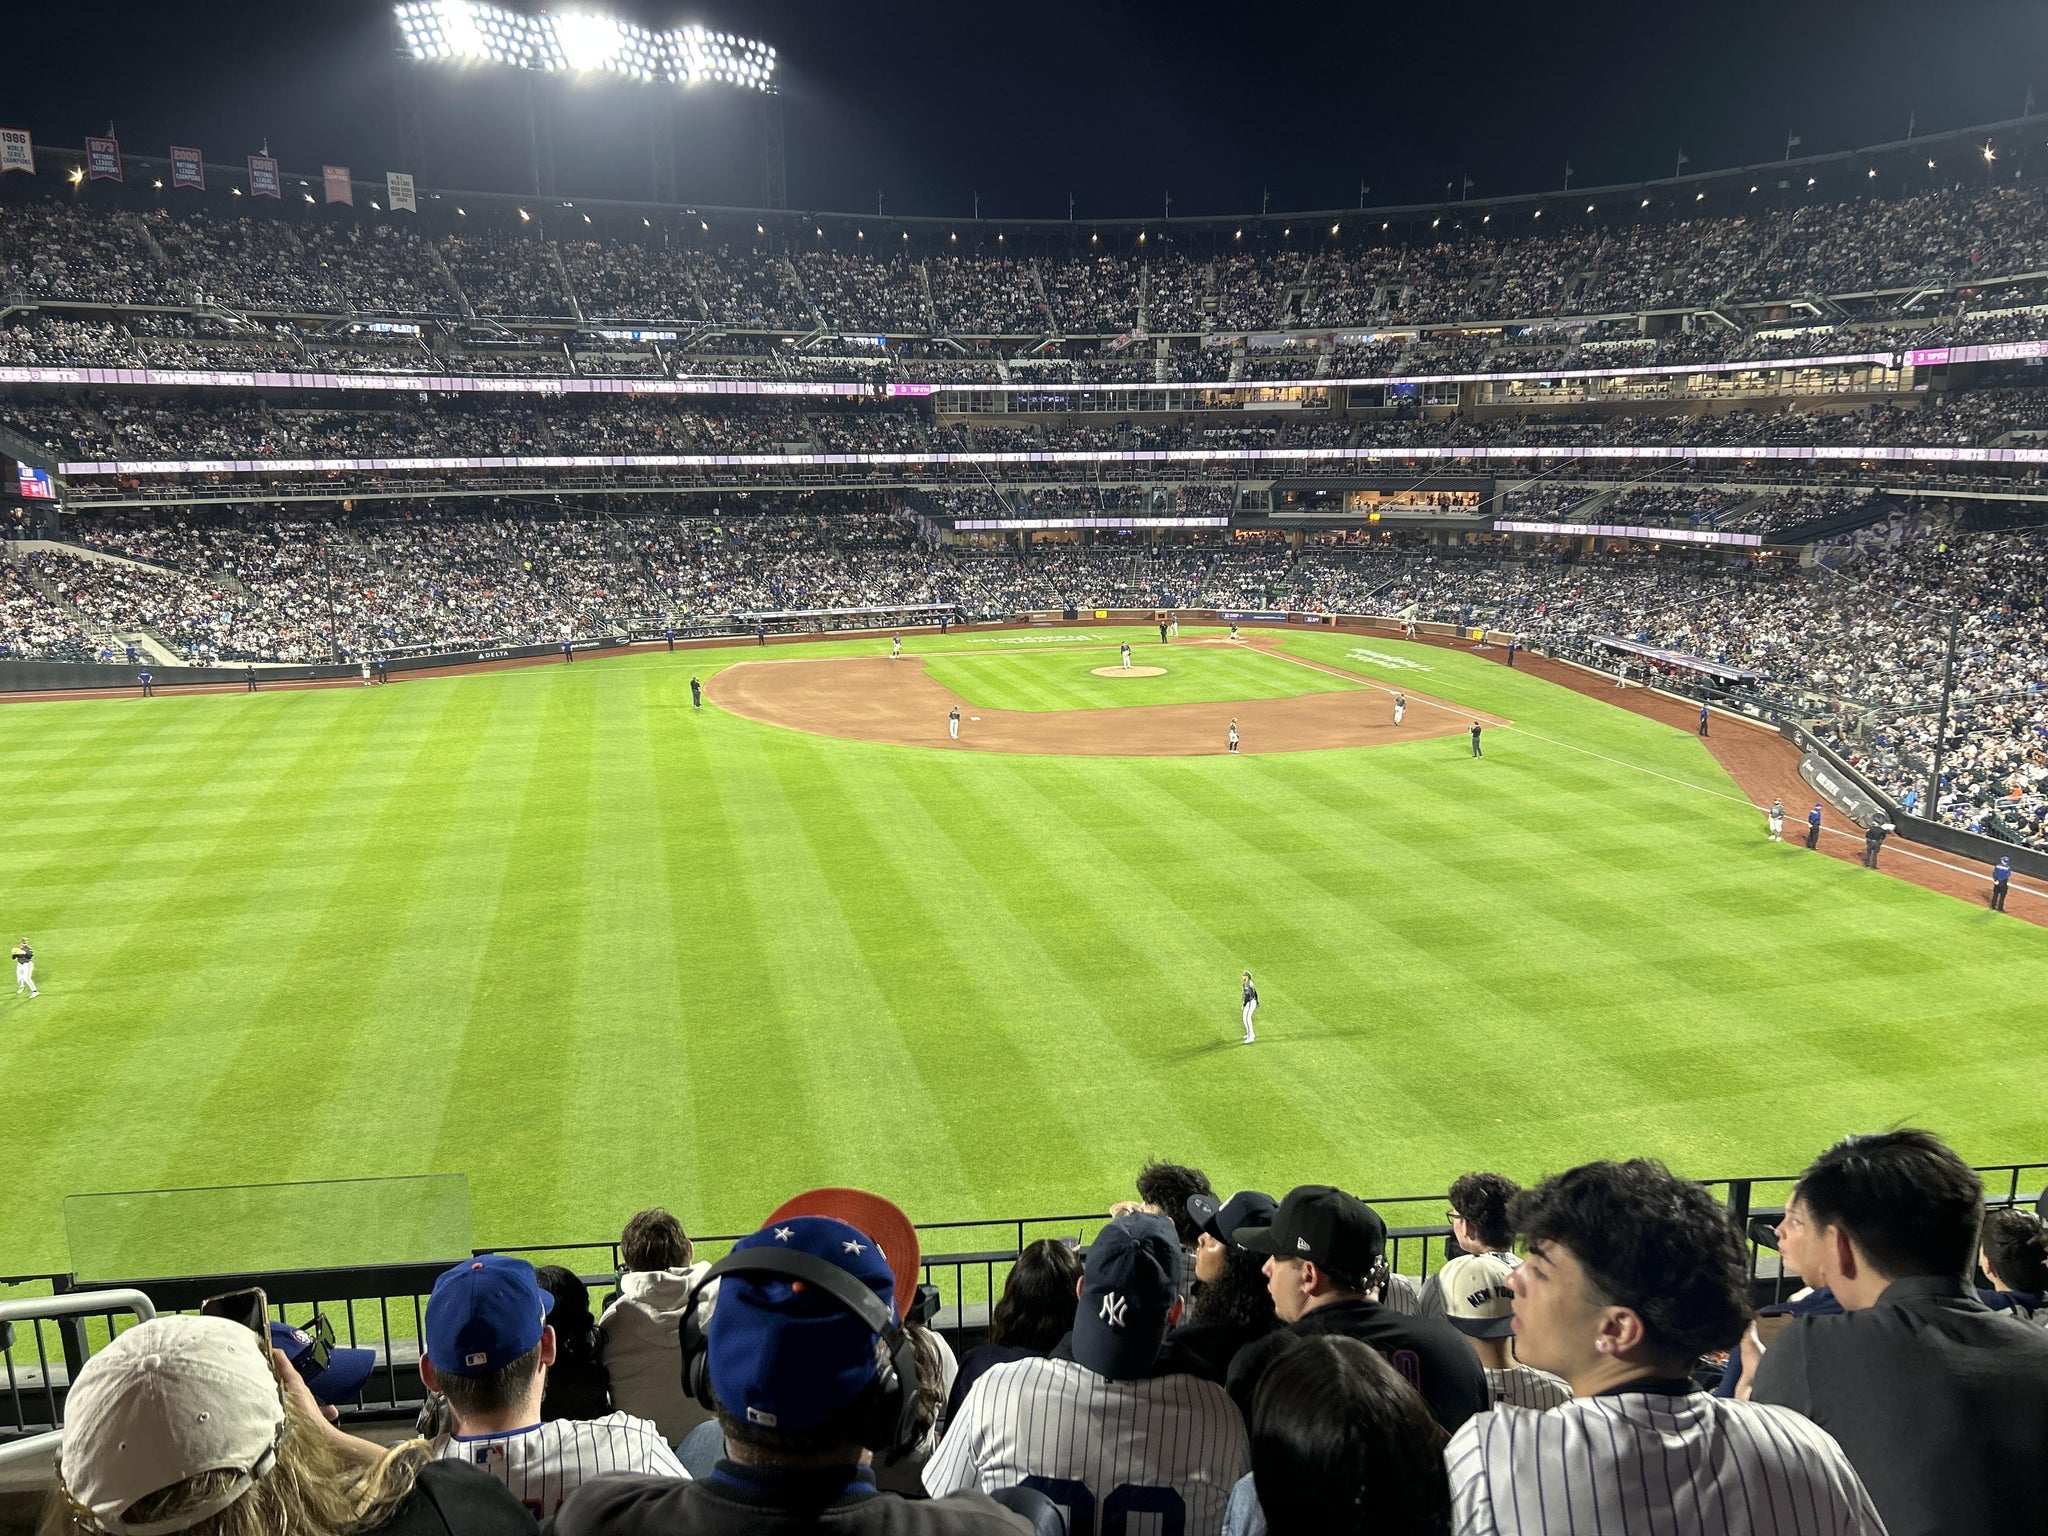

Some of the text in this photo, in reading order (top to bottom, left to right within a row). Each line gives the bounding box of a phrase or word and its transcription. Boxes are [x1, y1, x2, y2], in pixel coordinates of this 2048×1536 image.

[2, 132, 26, 144] 1986
[1988, 343, 2041, 358] YANKEES
[152, 373, 212, 384] YANKEES
[336, 377, 386, 388] YANKEES
[477, 380, 526, 391] YANKEES
[632, 382, 676, 392] YANKEES
[761, 384, 803, 394] YANKEES
[1467, 1285, 1515, 1307] NEW YOR
